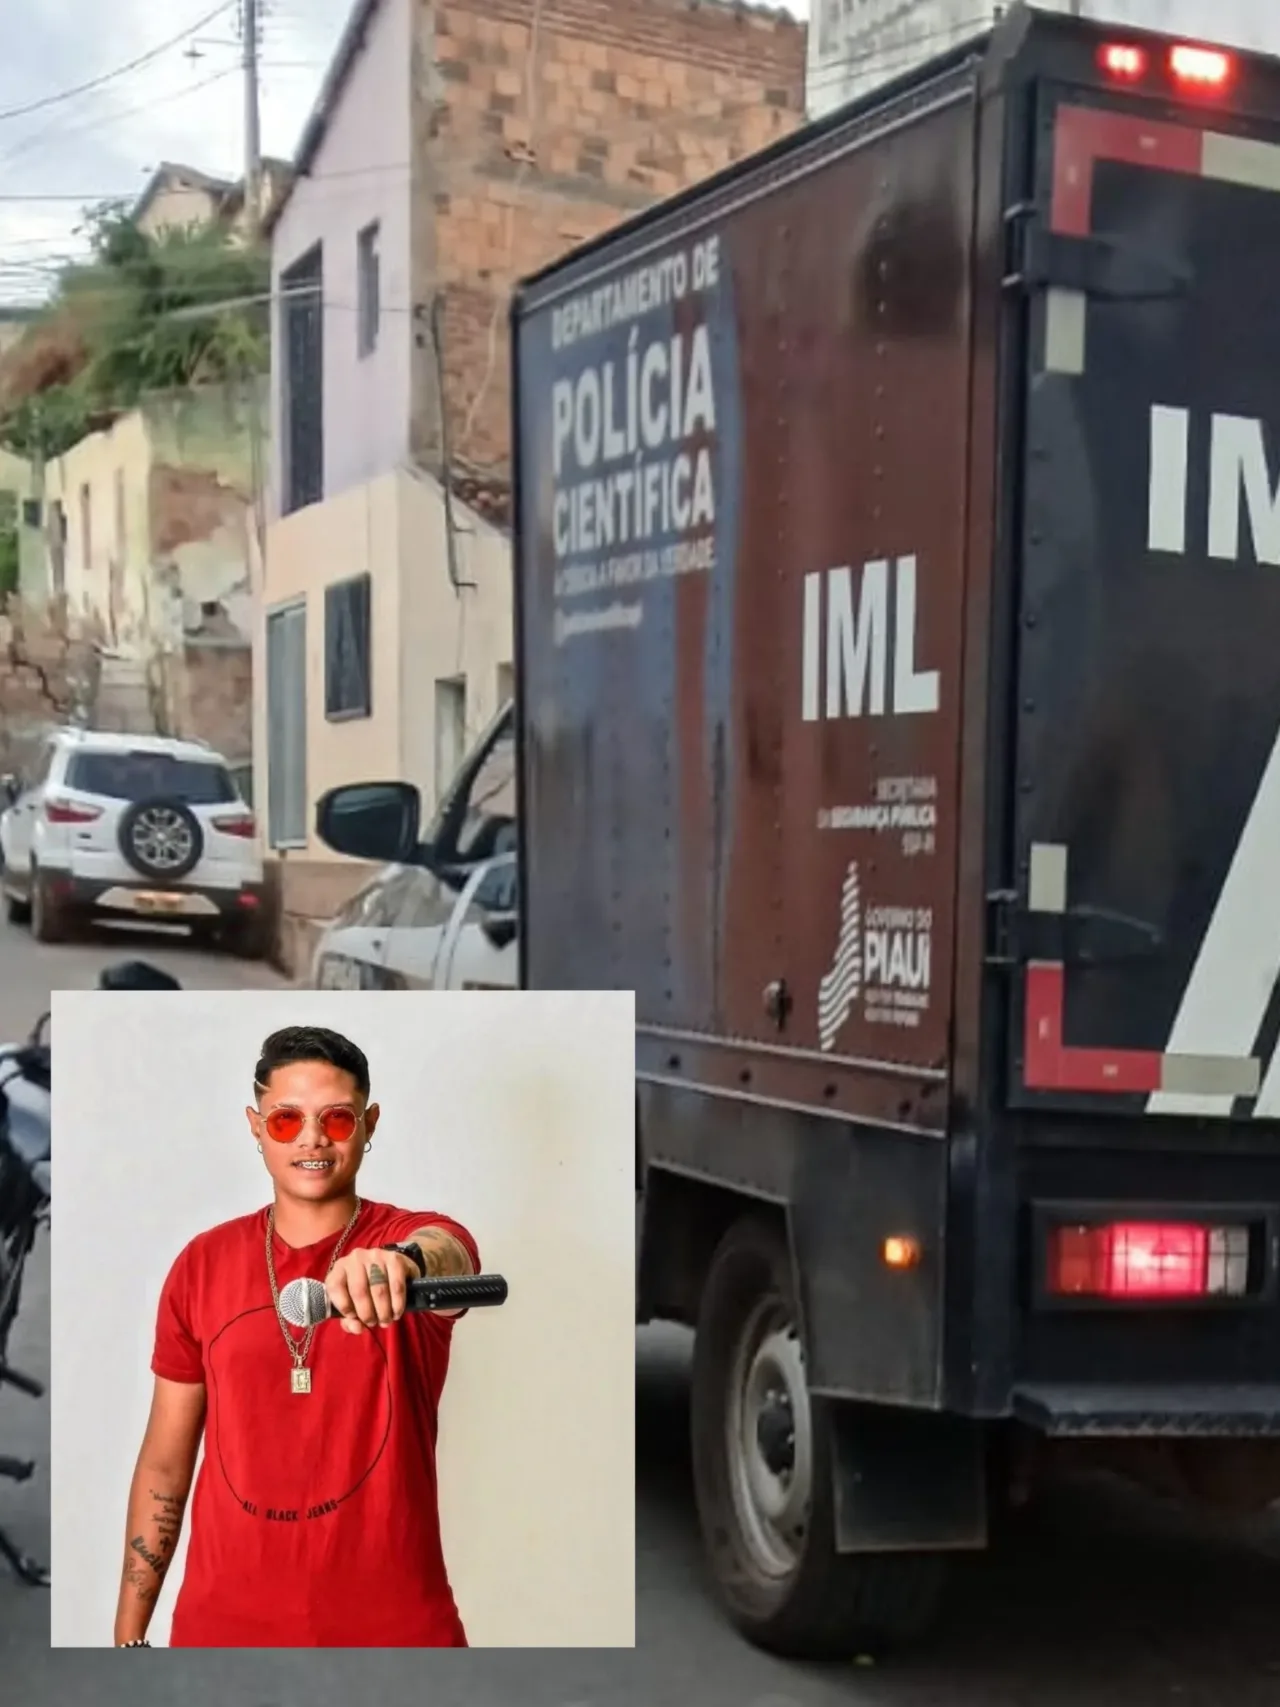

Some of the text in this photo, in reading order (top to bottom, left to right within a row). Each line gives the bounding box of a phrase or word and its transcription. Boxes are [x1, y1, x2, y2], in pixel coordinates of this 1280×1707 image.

[552, 234, 720, 351] DEPARTAMENTO DE
[552, 323, 716, 478] POLÍCIA
[553, 447, 715, 557] CIENTÍFICA
[802, 552, 941, 722] IML
[242, 1498, 338, 1522] ALL BLACK JEANS
